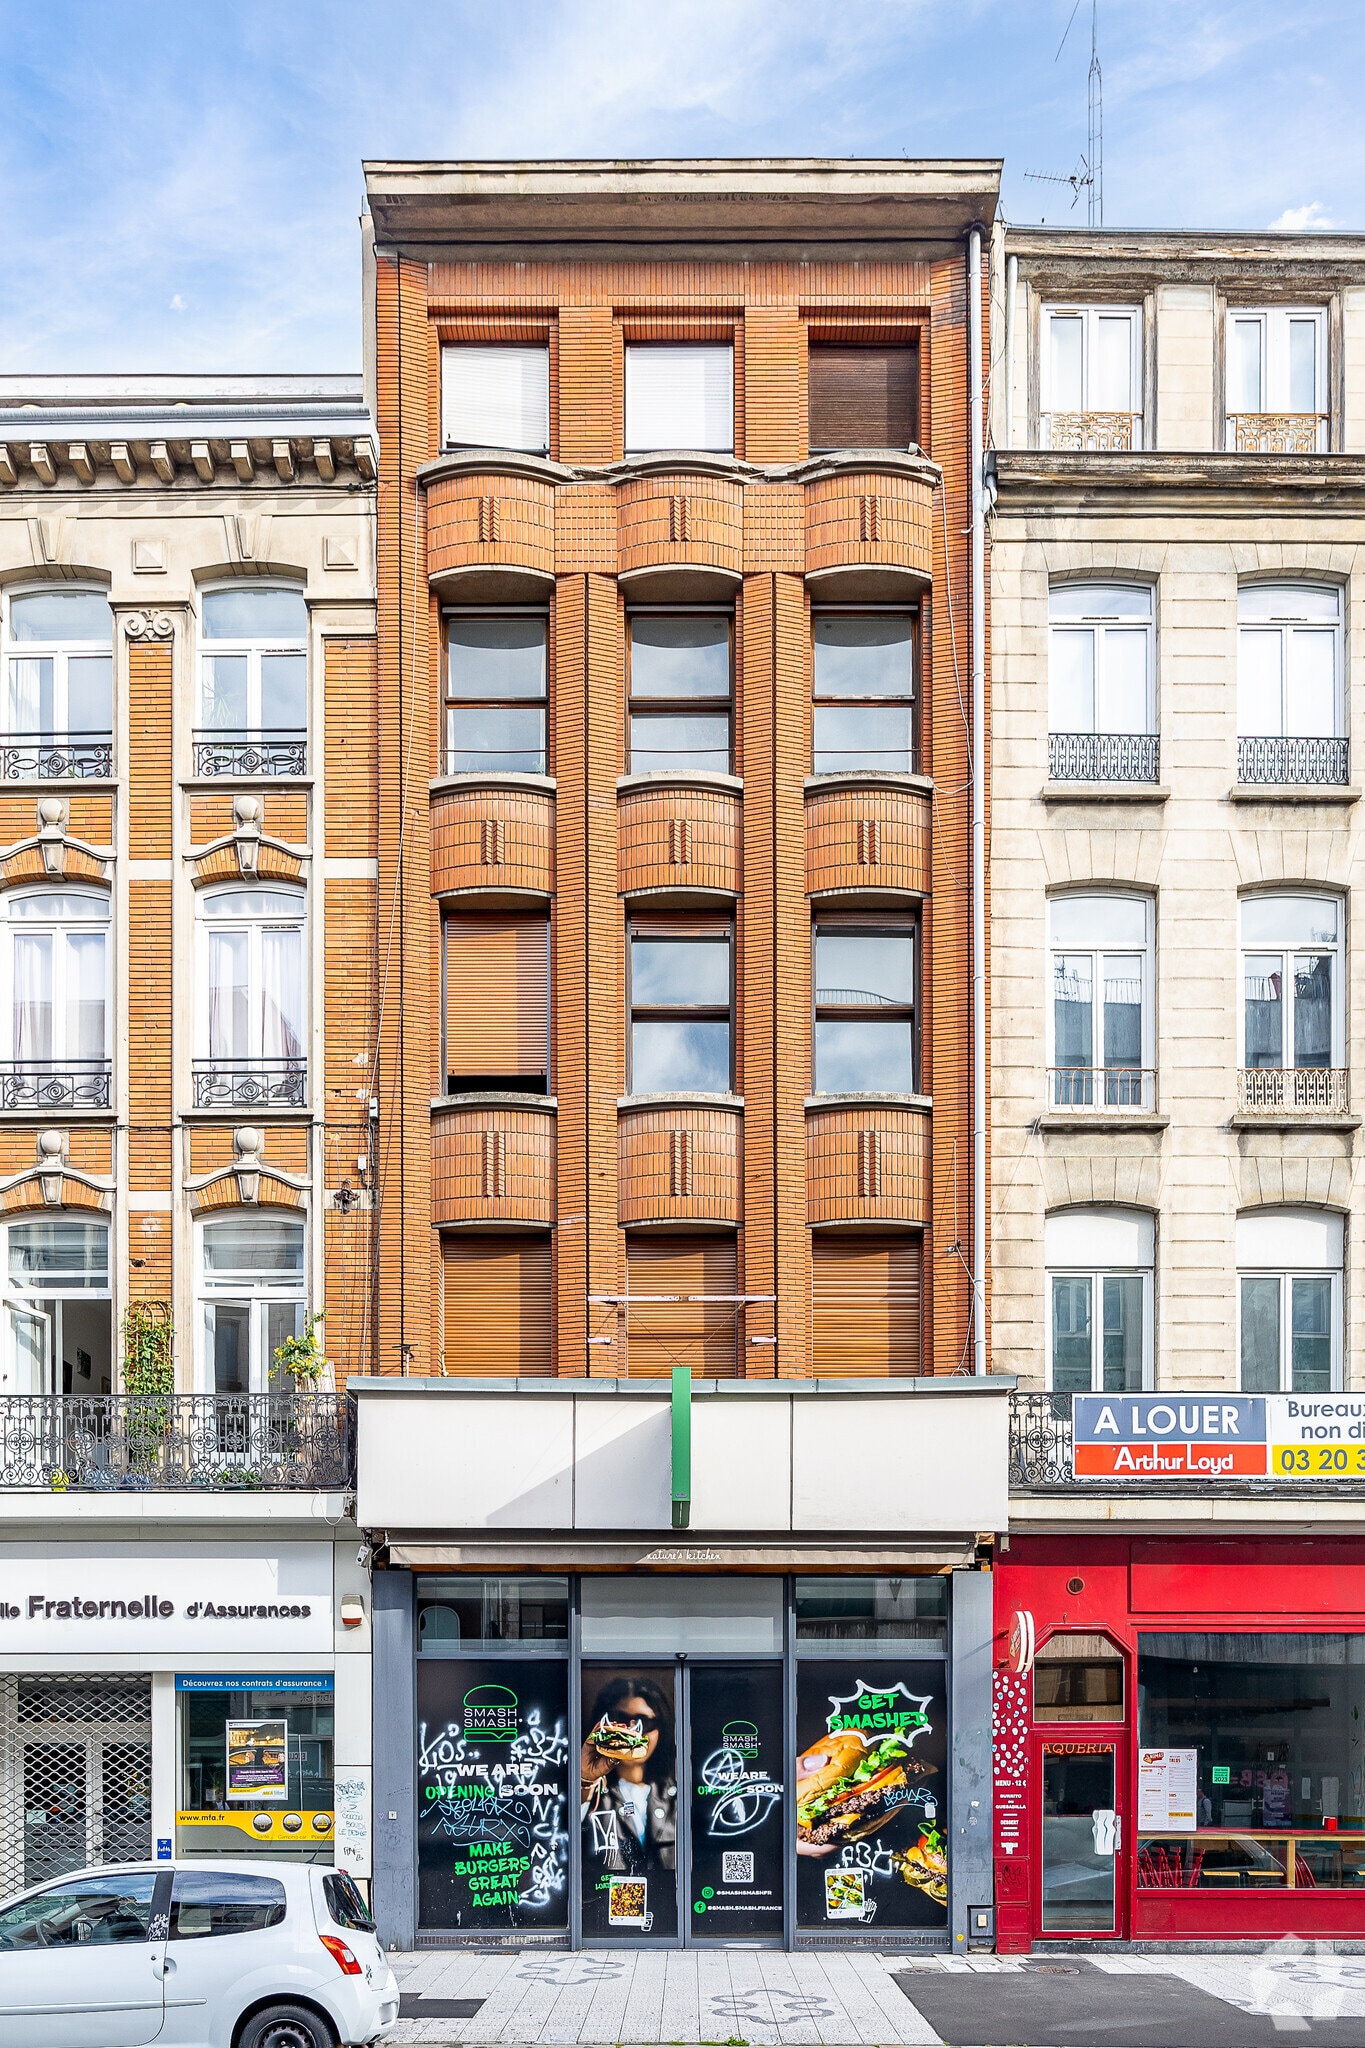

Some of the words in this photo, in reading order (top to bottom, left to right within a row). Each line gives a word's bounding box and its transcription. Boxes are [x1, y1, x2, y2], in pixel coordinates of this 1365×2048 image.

[1288, 1401, 1365, 1417] Bureau
[1093, 1406, 1120, 1434] A
[1131, 1405, 1240, 1435] LOUER
[1301, 1426, 1341, 1438] non
[1113, 1446, 1184, 1470] Arthur
[1186, 1445, 1233, 1474] Loyd
[1281, 1449, 1310, 1470] 03
[1318, 1449, 1348, 1470] 20
[646, 1550, 683, 1560] nature's
[686, 1548, 721, 1560] kitchen
[28, 1595, 175, 1618] Fraternelle
[186, 1602, 311, 1617] d'Assurances
[182, 1679, 223, 1687] Découvrez
[275, 1679, 322, 1687] d'assurance
[858, 1693, 900, 1710] GET
[464, 1708, 517, 1717] SMASH
[829, 1711, 929, 1730] SMASHED
[464, 1718, 517, 1728] SMASH
[1043, 1743, 1113, 1755] AQUERIA
[457, 1764, 489, 1777] WE
[491, 1763, 533, 1777] ARE
[718, 1772, 739, 1780] WE
[740, 1771, 768, 1779] ARE
[425, 1784, 495, 1800] OPENING
[500, 1783, 558, 1796] SOON
[746, 1784, 785, 1793] SOON
[179, 1813, 225, 1821] www.mfa.fr
[469, 1841, 514, 1858] MAKE
[454, 1856, 531, 1876] BURGERS
[468, 1871, 522, 1891] GREAT
[472, 1890, 520, 1907] AGAIN
